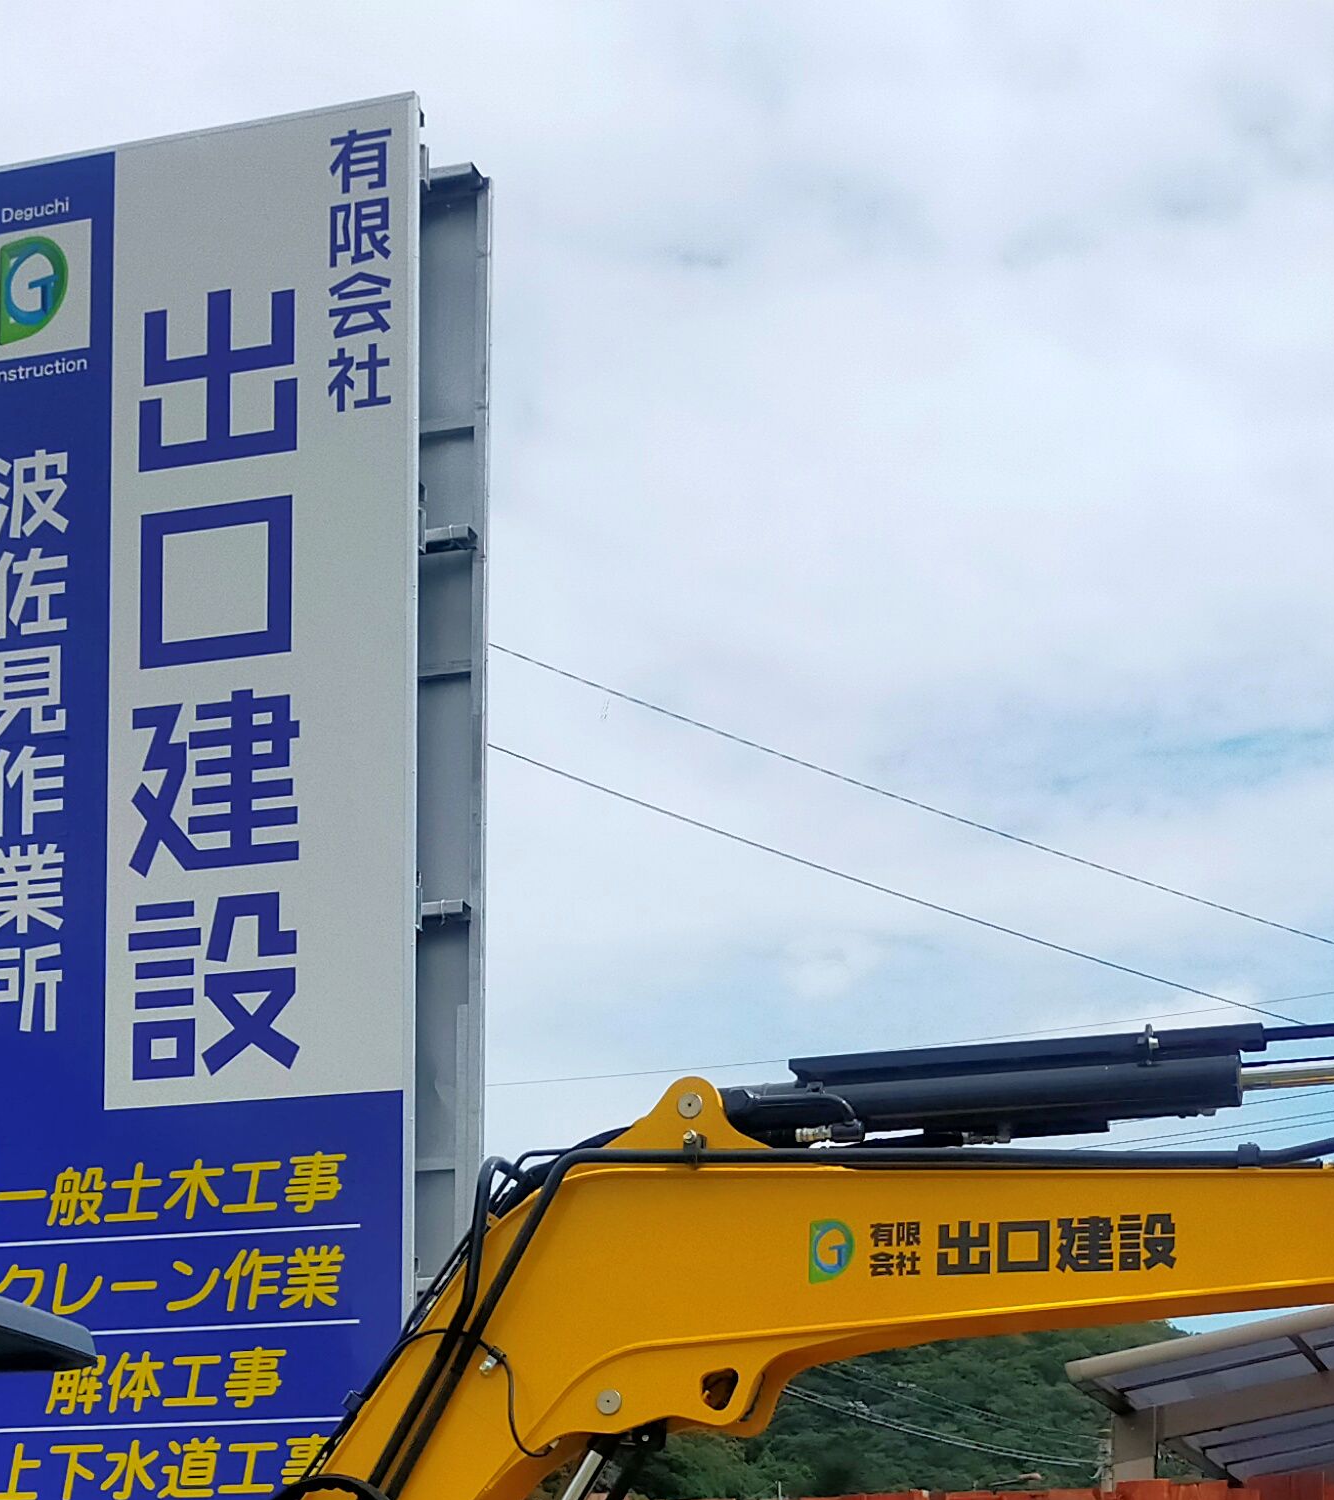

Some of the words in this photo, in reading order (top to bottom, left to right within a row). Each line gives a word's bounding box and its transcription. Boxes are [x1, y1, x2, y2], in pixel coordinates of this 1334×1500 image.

[1, 197, 69, 223] Deguchi
[328, 128, 392, 412] 有限会社
[128, 288, 301, 1081] 出口建設
[869, 1221, 921, 1248] 有限
[869, 1251, 921, 1277] 会社
[936, 1213, 1178, 1276] 出口建設
[45, 1346, 287, 1416] 解体工事
